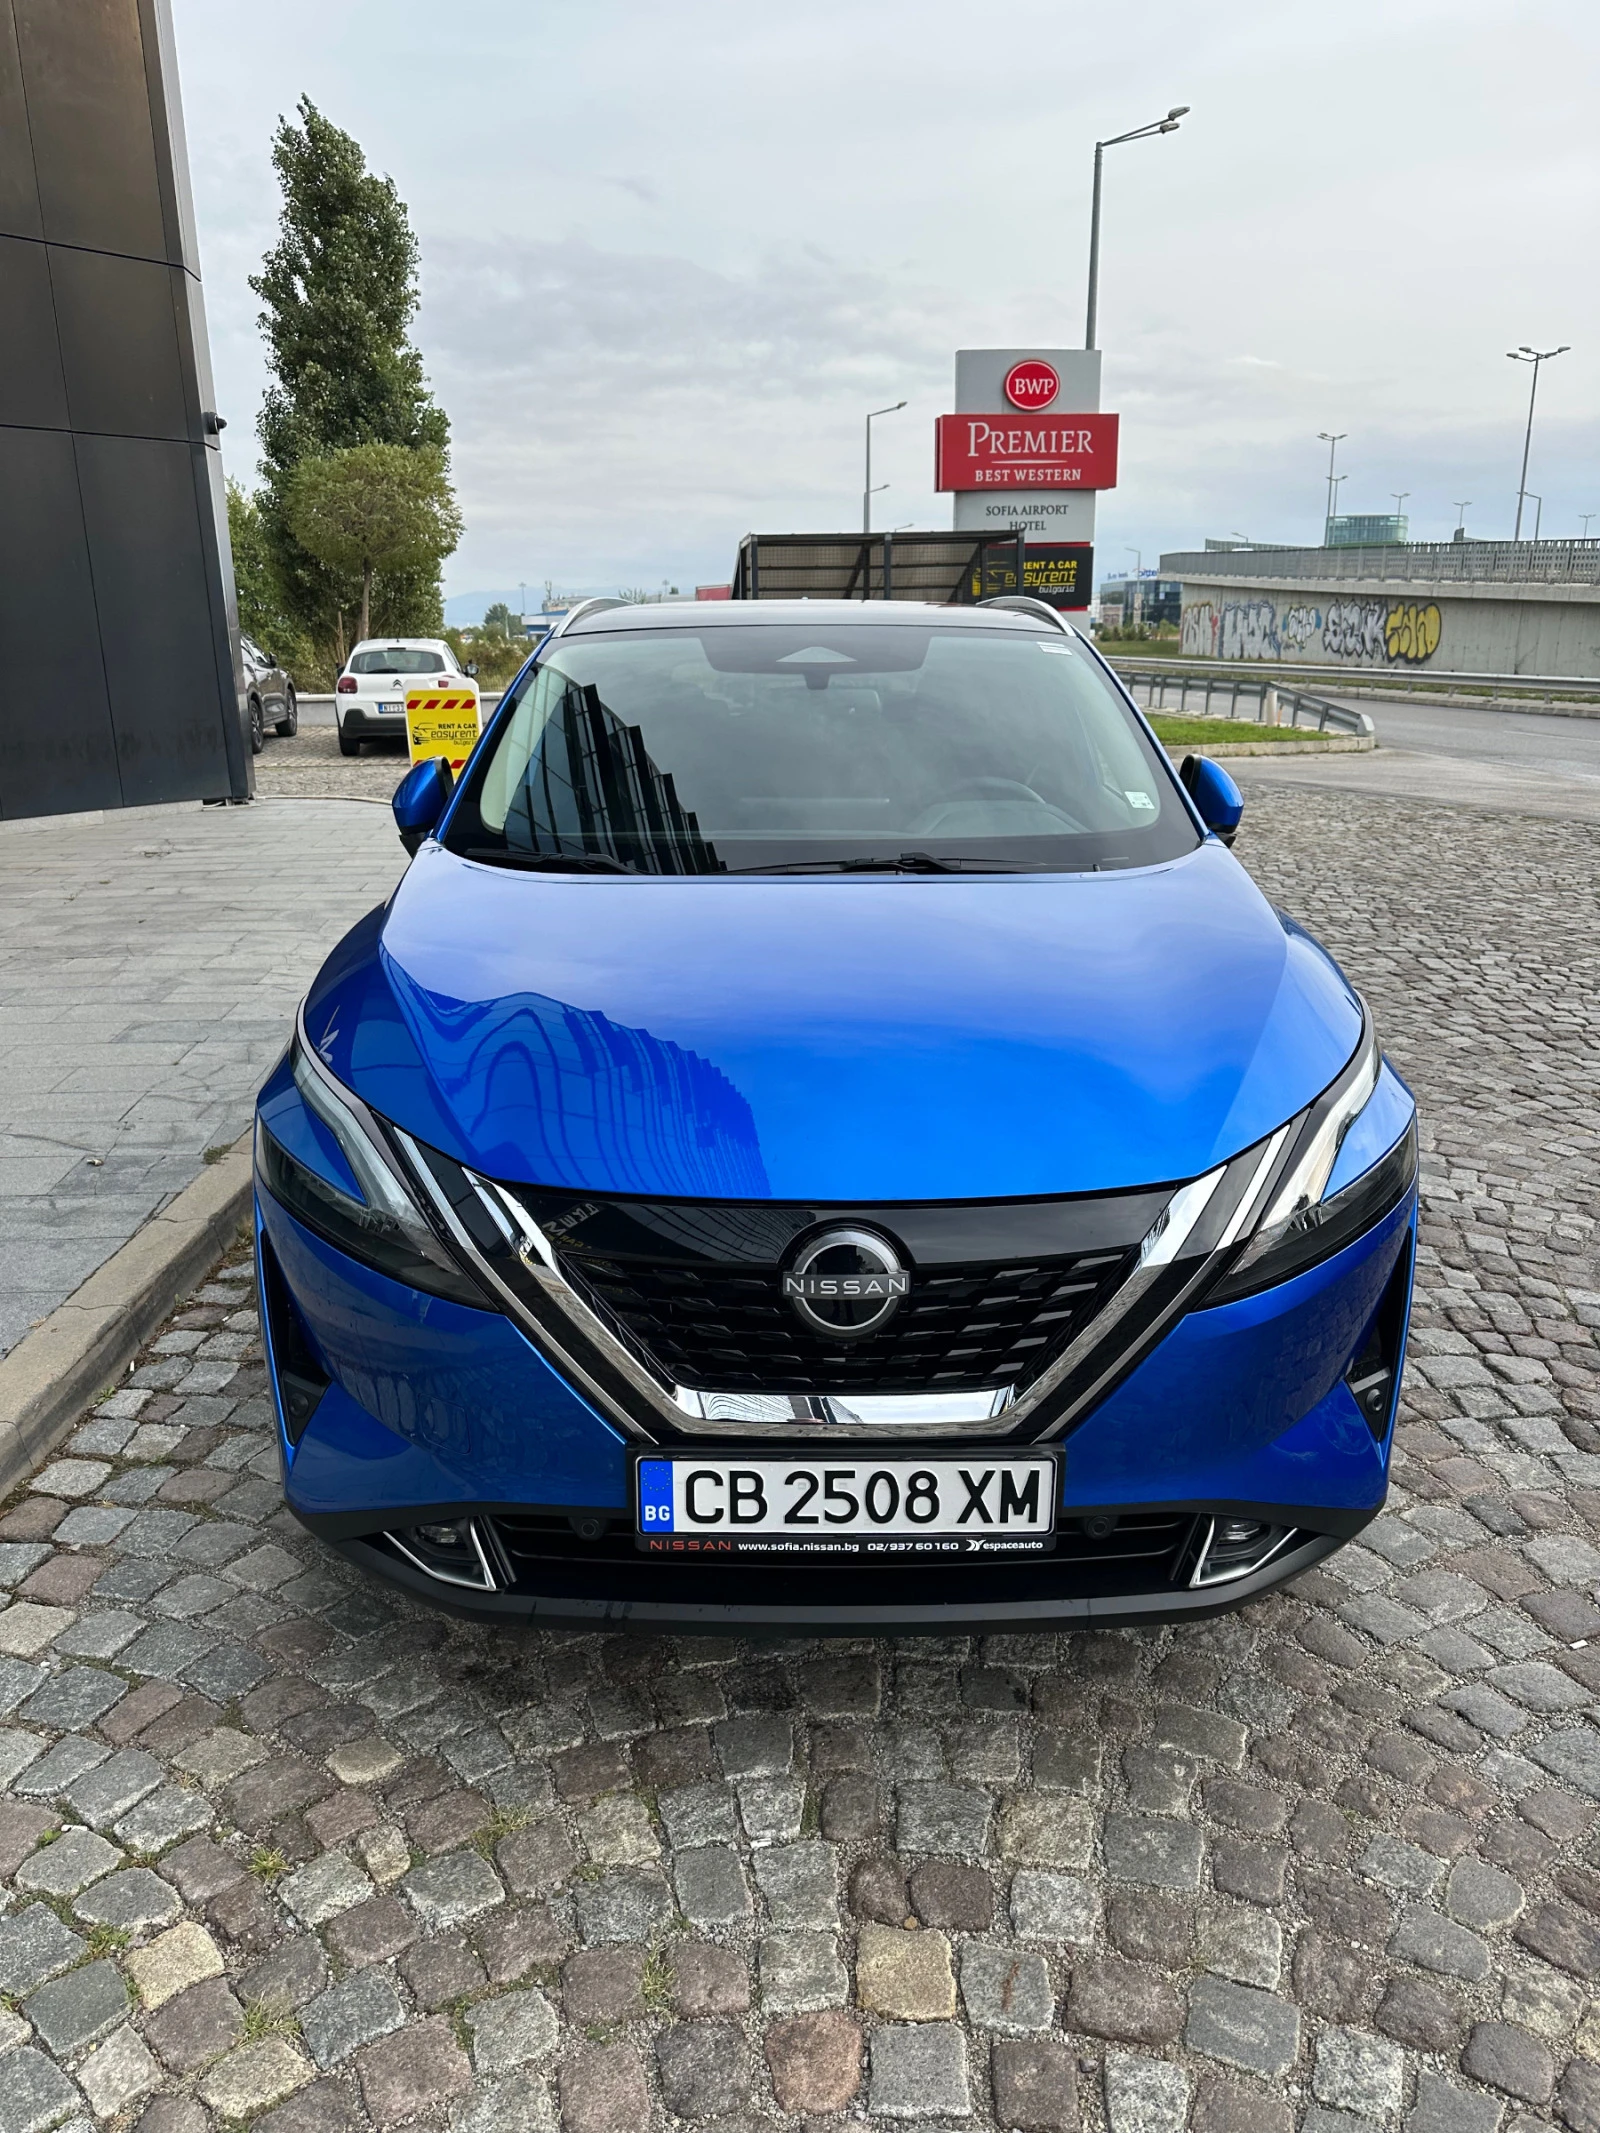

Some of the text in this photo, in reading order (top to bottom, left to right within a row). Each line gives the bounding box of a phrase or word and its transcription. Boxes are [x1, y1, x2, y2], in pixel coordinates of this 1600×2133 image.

[1014, 378, 1054, 395] BWP
[967, 422, 1094, 457] PREMIER
[975, 469, 1082, 482] BEST WESTERN
[985, 505, 1069, 516] SOFIA AIRPORT
[1009, 521, 1047, 531] HOTEL
[1058, 561, 1078, 569] CAR
[1004, 569, 1077, 587] esyrent
[1038, 586, 1075, 595] bulgaria
[430, 730, 478, 740] easyrent
[786, 1277, 906, 1295] NISSAN
[685, 1469, 1040, 1524] CB 2508 XM
[644, 1505, 671, 1521] BG
[650, 1540, 732, 1551] NISSAN
[738, 1542, 860, 1552] www.sofia.nissan.bg
[982, 1540, 1044, 1550] espaceauto
